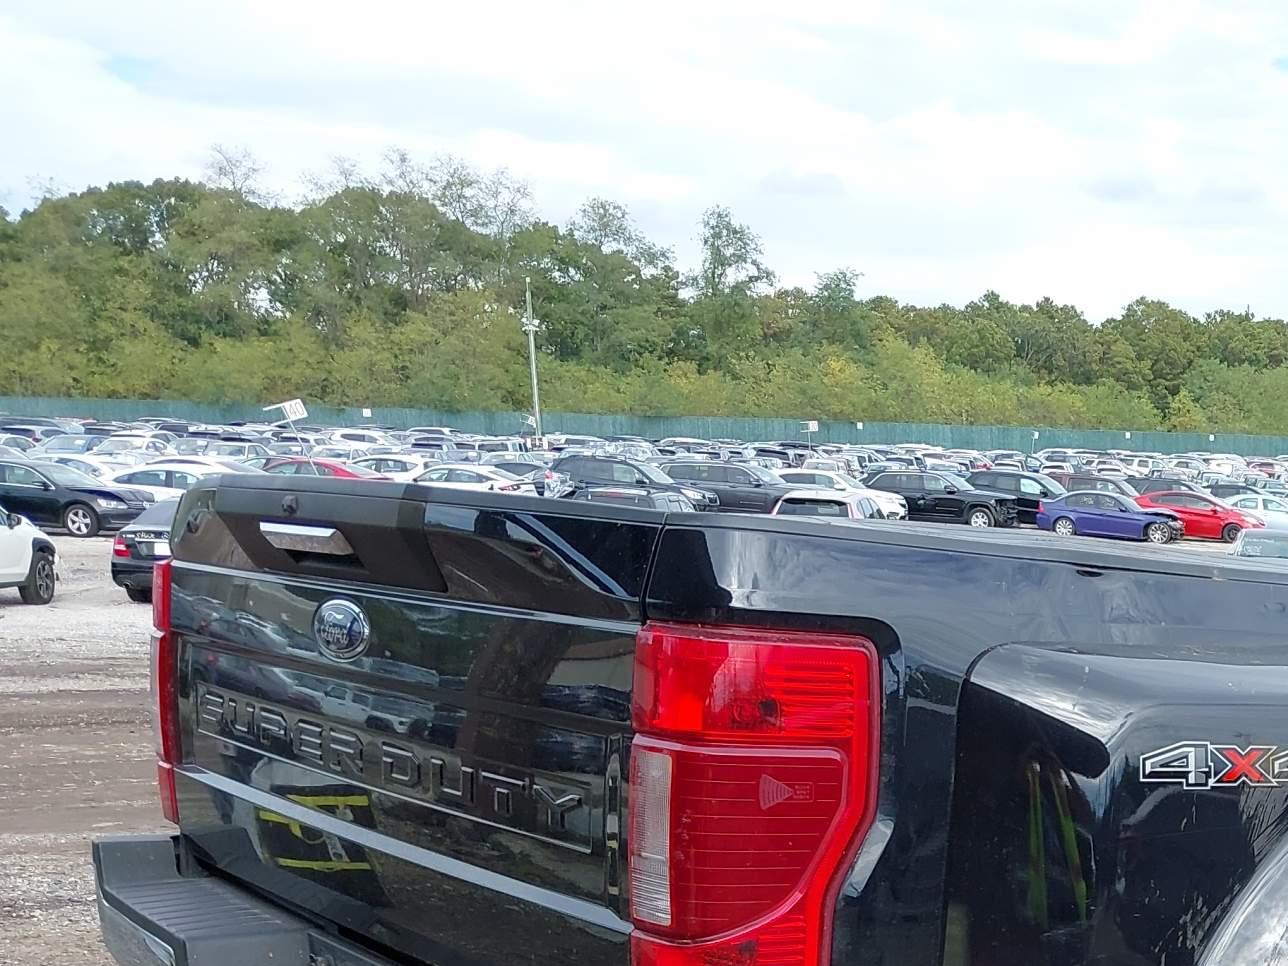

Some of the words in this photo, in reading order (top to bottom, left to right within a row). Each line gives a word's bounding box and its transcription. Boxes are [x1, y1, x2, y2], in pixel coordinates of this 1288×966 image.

[321, 610, 351, 646] Ford
[201, 688, 364, 778] SUPER
[381, 740, 584, 831] DUTY
